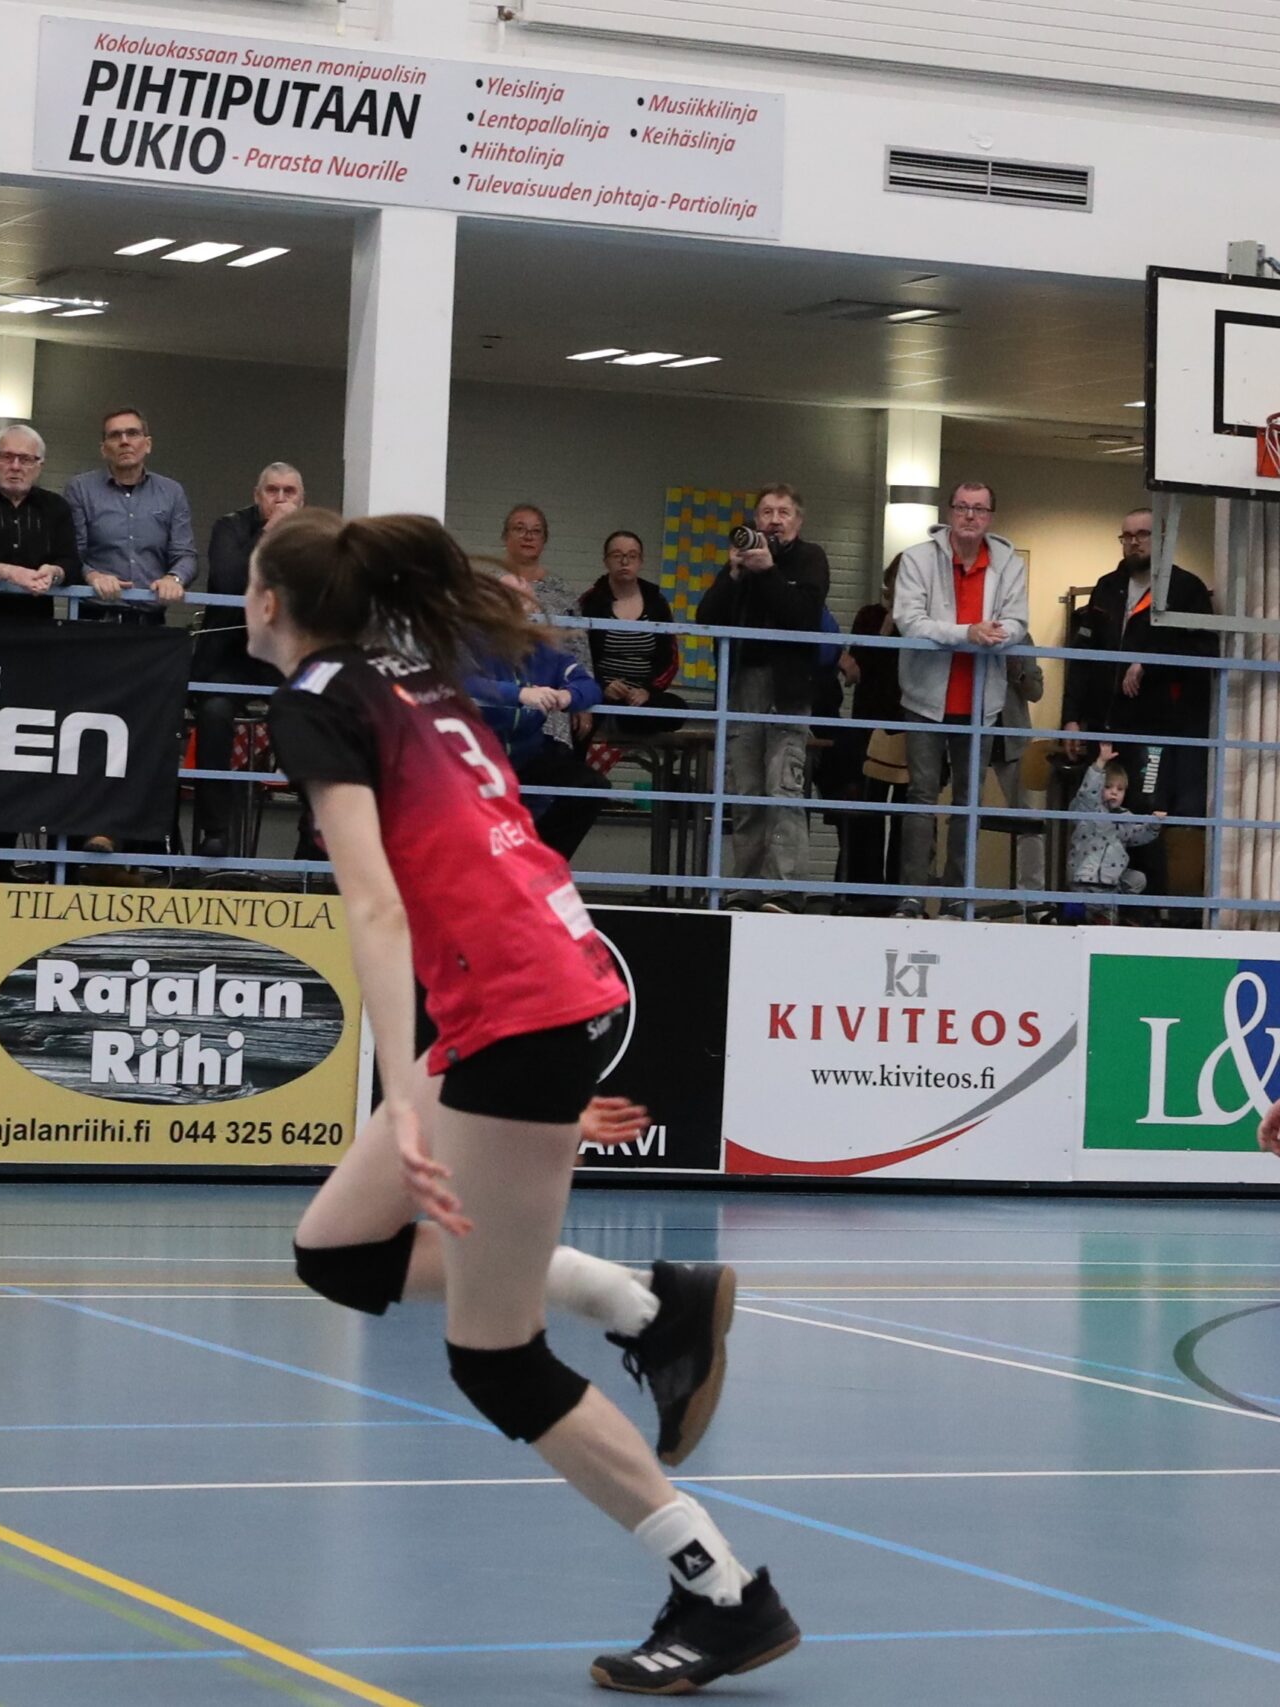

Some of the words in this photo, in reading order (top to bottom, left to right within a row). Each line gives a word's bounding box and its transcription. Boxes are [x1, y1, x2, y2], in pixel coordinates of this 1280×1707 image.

[94, 33, 238, 65] Kokoluokassaan
[241, 49, 312, 73] Suomen
[317, 59, 427, 85] monipuolisin
[82, 60, 422, 139] PIHTIPUTAAN
[486, 77, 565, 104] Yleislinja
[477, 109, 609, 142] Lentopallolinja
[647, 94, 758, 125] Musiikkilinja
[69, 115, 226, 175] LUKIO
[471, 141, 565, 170] Hiihtolinja
[641, 126, 736, 154] Keihäslinja
[244, 147, 321, 173] Parasta
[327, 156, 408, 182] Nuorille
[466, 173, 592, 202] Tulevaisuuden
[433, 718, 507, 800] 3
[1142, 754, 1161, 793] PUMA
[7, 890, 336, 930] TILAUSRAVINTOLA
[34, 958, 304, 1028] Rajalan
[767, 1002, 1043, 1048] KIVITEOS
[90, 1028, 245, 1087] Riihi
[811, 1064, 996, 1090] www.kiviteos.fi
[168, 1120, 216, 1144] 044
[224, 1121, 273, 1145] 325
[280, 1122, 343, 1146] 6420
